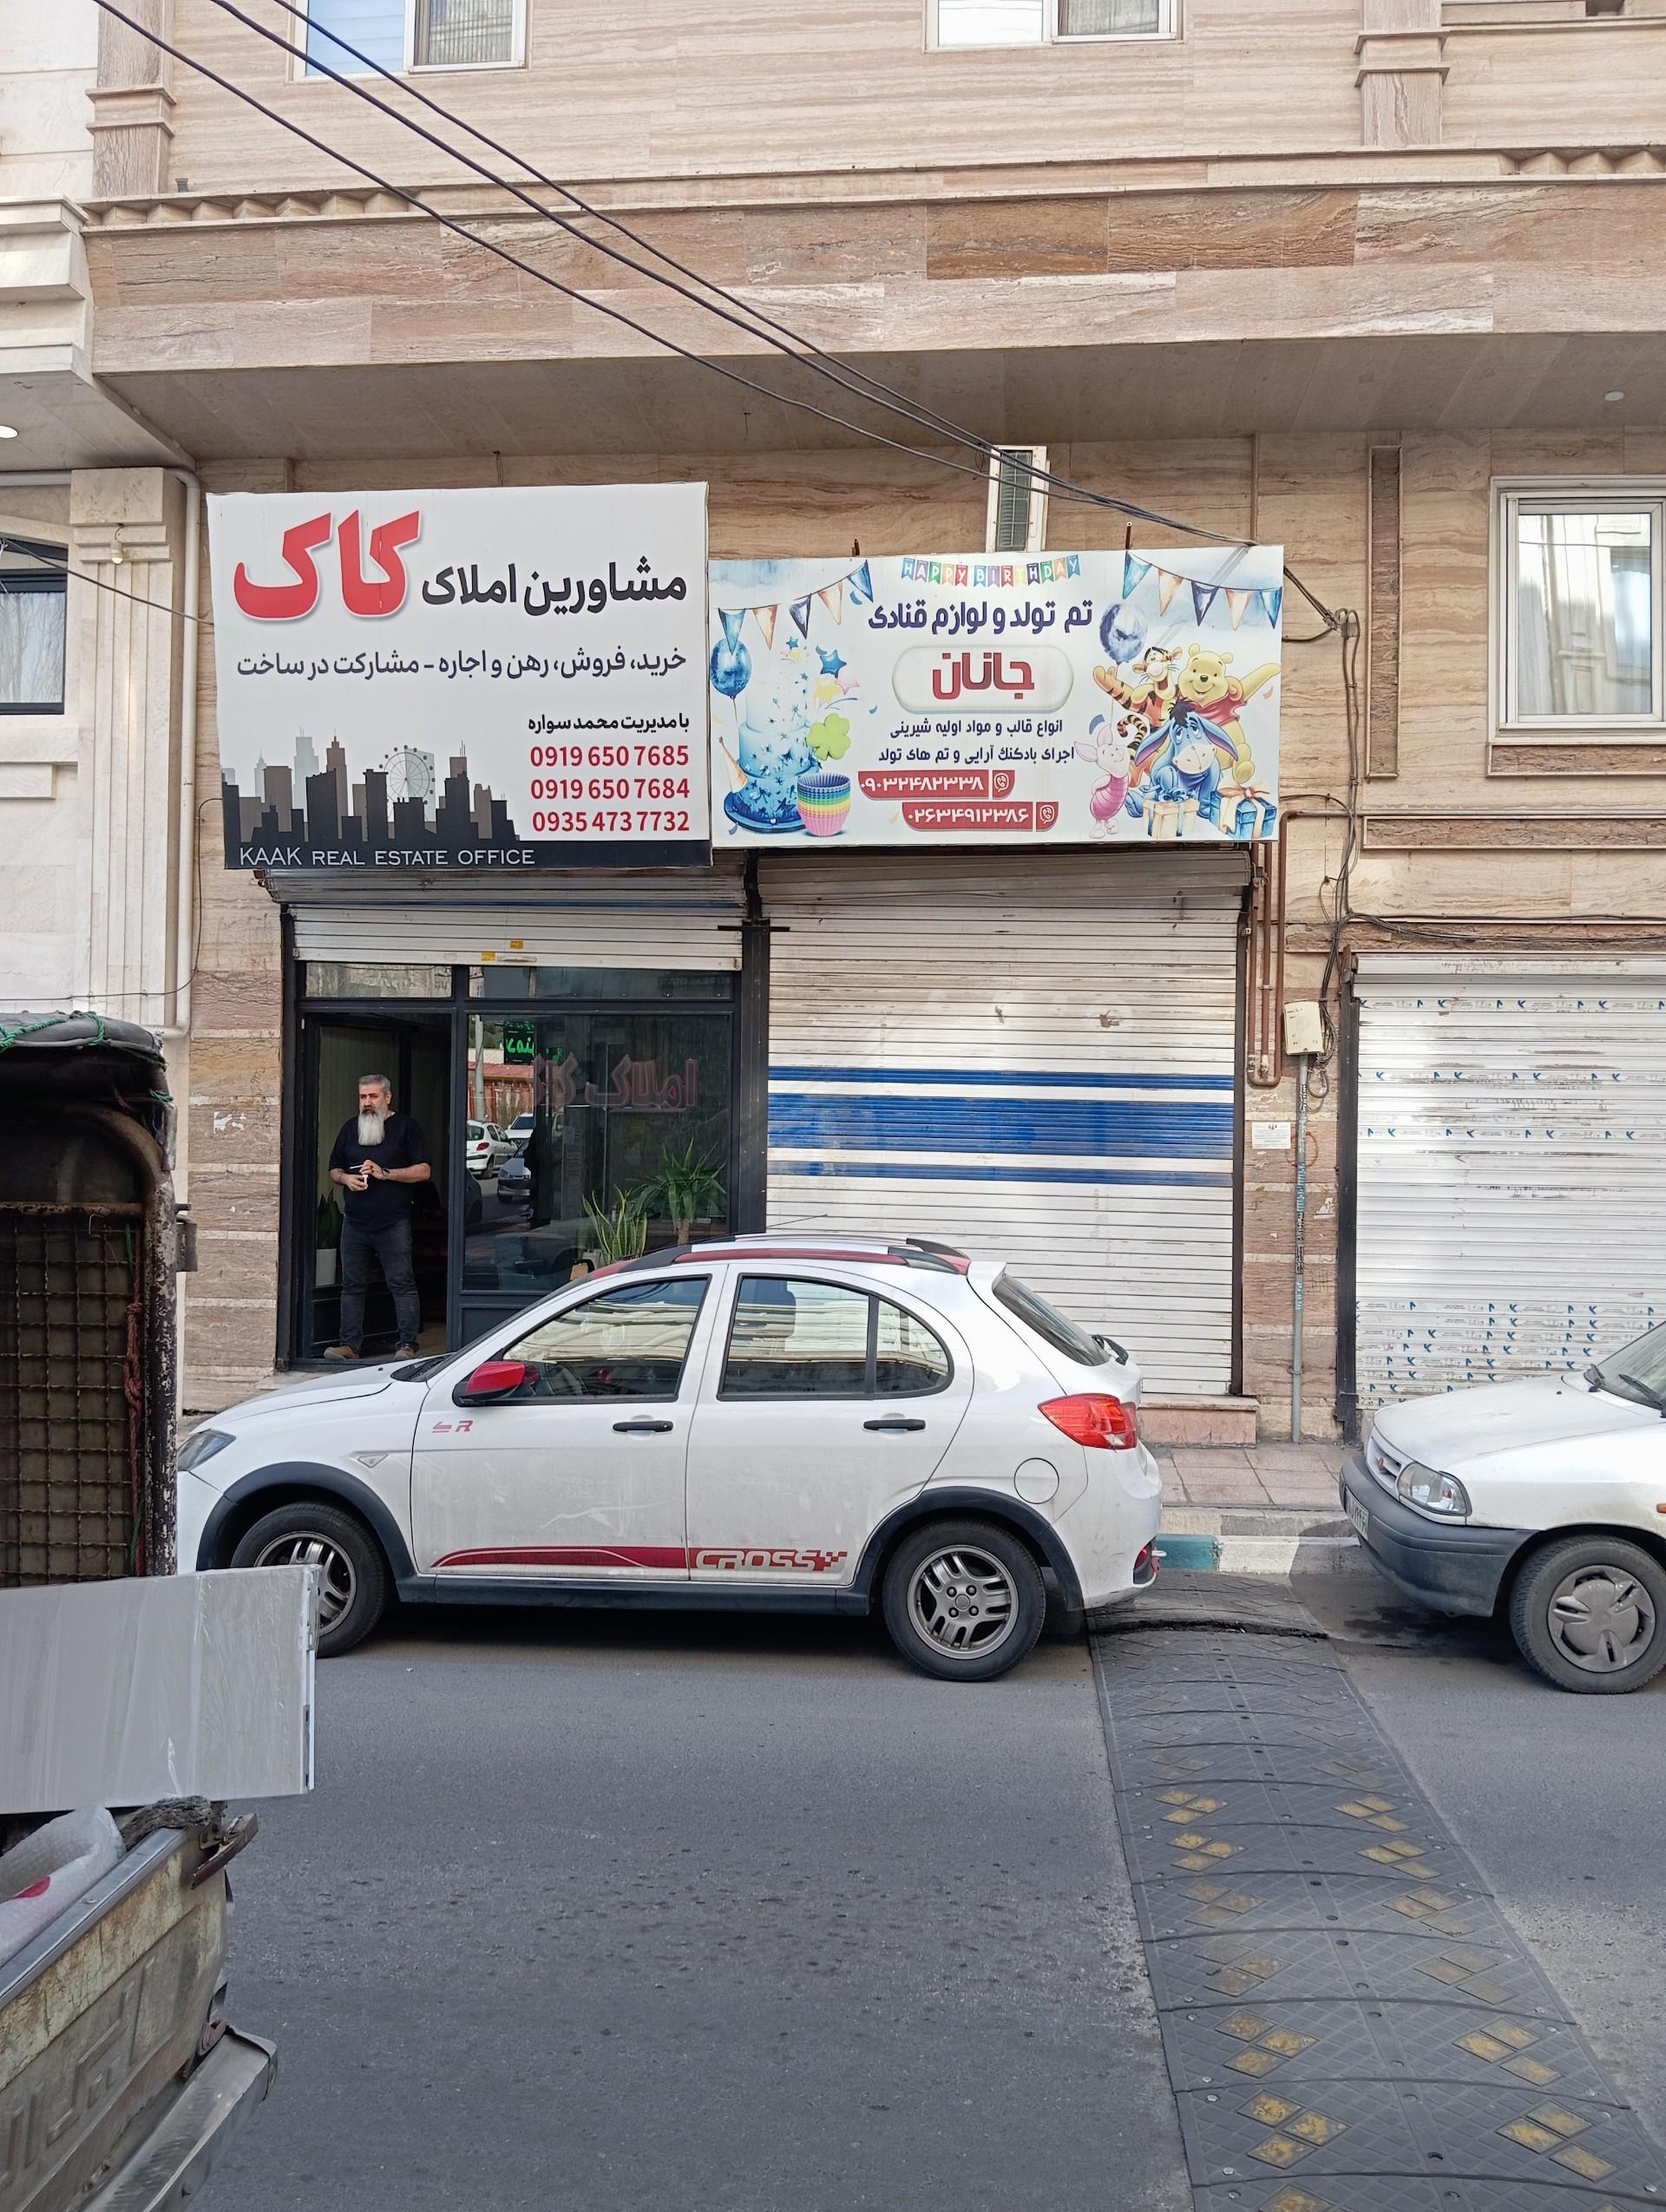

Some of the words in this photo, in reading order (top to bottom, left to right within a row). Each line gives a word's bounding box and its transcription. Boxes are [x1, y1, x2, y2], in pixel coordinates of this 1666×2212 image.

[233, 509, 421, 619] کاک
[903, 562, 967, 582] HAPPY
[975, 560, 1079, 583] BIRTHDAY
[422, 562, 517, 605] املاک
[523, 555, 687, 617] مشاورین
[868, 599, 928, 630] قنادی
[931, 601, 987, 636] لوازم
[993, 607, 1006, 635] و
[1009, 600, 1056, 635] تولد
[1064, 599, 1093, 633] تم
[237, 652, 305, 676] ساخت
[306, 658, 330, 681] در
[333, 650, 419, 681] مشارکت
[438, 649, 487, 679] اجاره
[490, 658, 502, 679] و
[507, 654, 549, 680] رهن
[932, 651, 1034, 700] جانان
[528, 714, 572, 735] سواره
[573, 717, 619, 730] محمد
[620, 716, 678, 734] مدیریت
[679, 712, 690, 733] با
[889, 717, 932, 739] شیرینی
[935, 719, 961, 737] اولیه
[966, 719, 991, 736] مواد
[995, 723, 1002, 736] و
[1007, 718, 1033, 737] قالب
[1036, 719, 1063, 737] انواع
[530, 746, 583, 768] 0919
[587, 745, 630, 768] 650
[633, 744, 690, 767] 7685
[878, 748, 902, 765] تولد
[906, 747, 931, 761] های
[935, 747, 949, 764] تم
[953, 749, 961, 763] و
[964, 744, 994, 765] آرایی
[1041, 746, 1074, 764] اجرای
[530, 778, 584, 800] 0919
[587, 778, 630, 800] 650
[633, 777, 691, 799] 7684
[532, 811, 588, 834] 0935
[592, 811, 633, 833] 473
[636, 810, 690, 833] 7732
[239, 847, 302, 866] KAAK
[312, 850, 365, 866] REAL
[375, 850, 449, 866] ESTATE
[457, 849, 535, 865] OFFICE
[696, 1549, 816, 1573] CROSS
